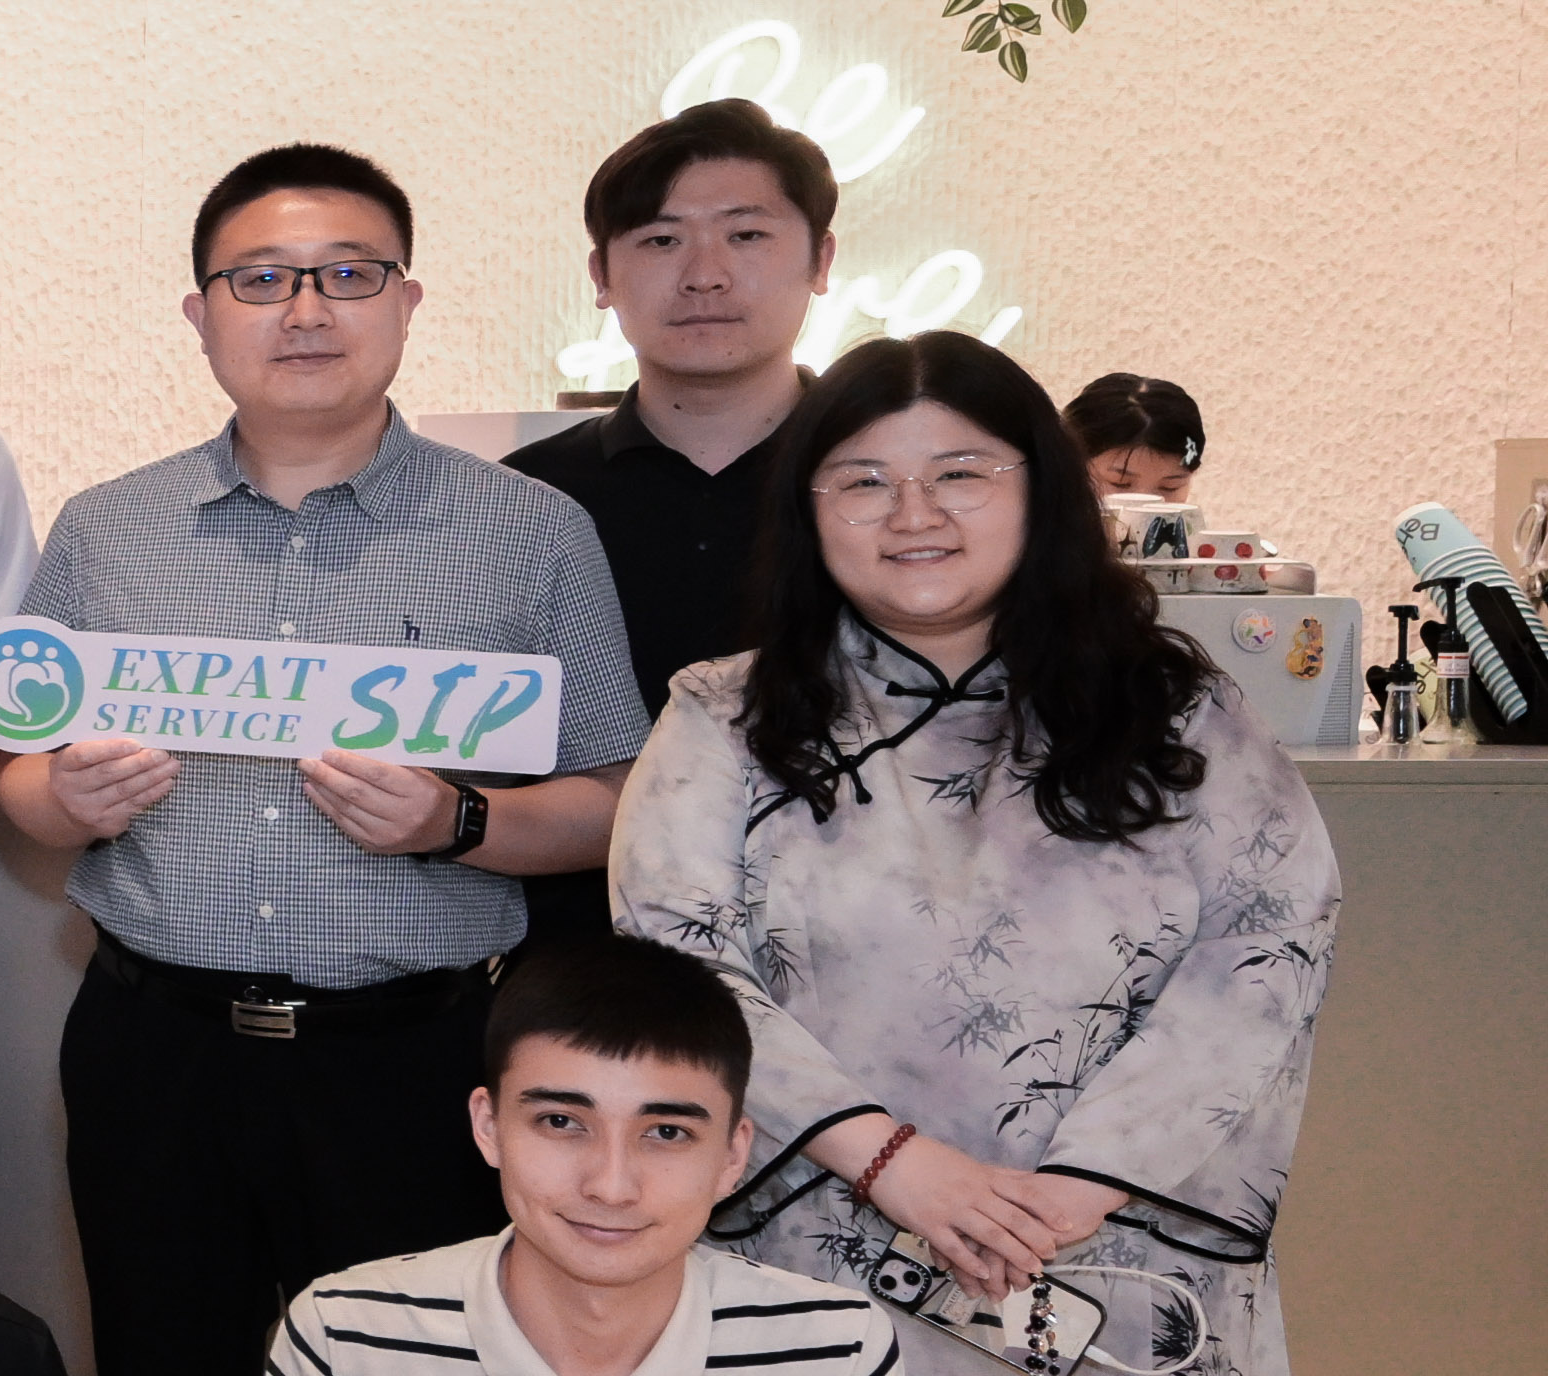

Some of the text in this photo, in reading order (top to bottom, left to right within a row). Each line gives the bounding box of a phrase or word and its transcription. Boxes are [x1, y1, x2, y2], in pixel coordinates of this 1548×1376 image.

[101, 646, 327, 702] EXPAT
[92, 702, 302, 744] SERVICE
[332, 661, 544, 760] SIP
